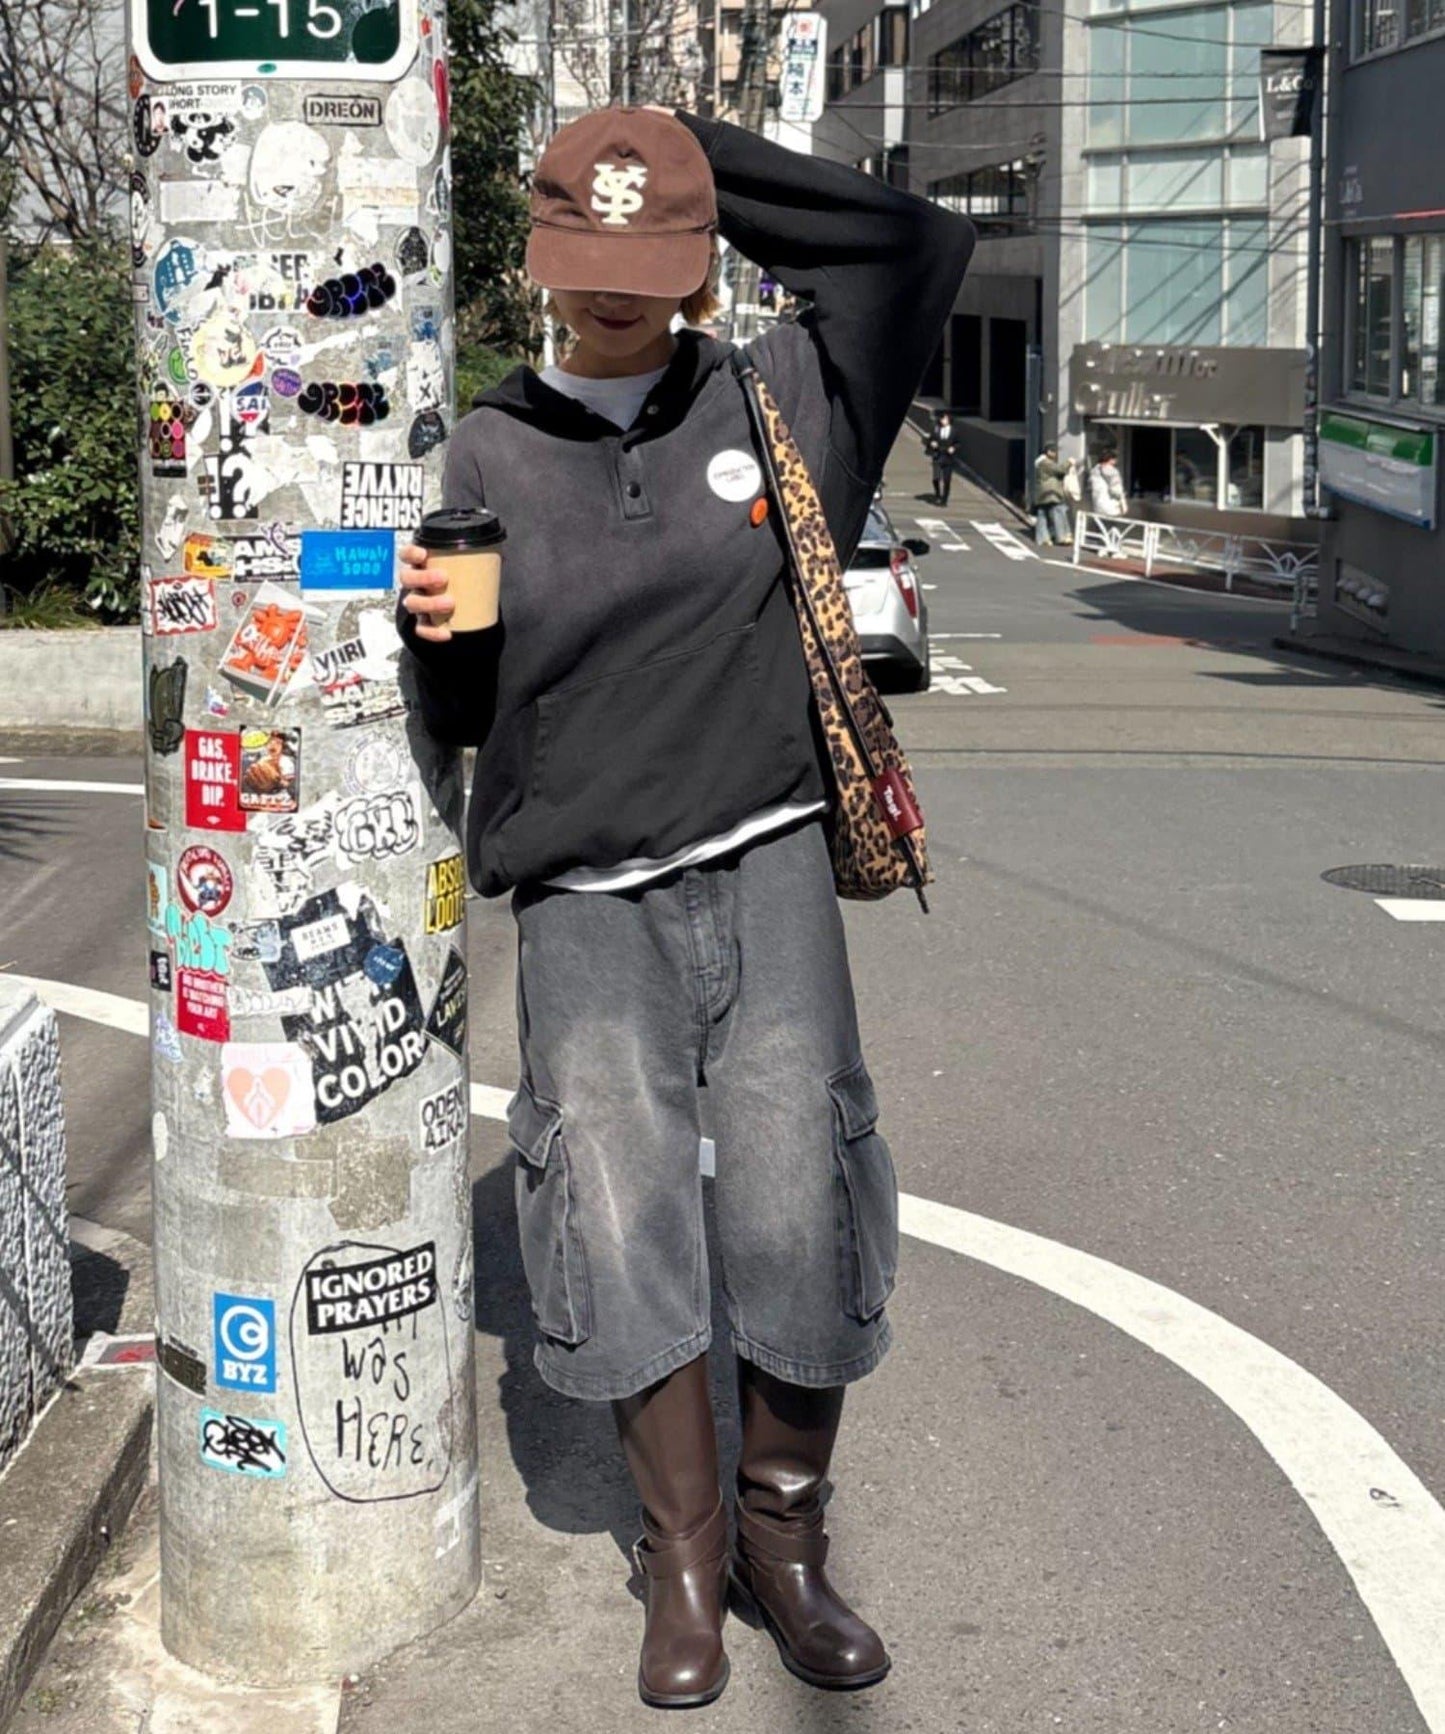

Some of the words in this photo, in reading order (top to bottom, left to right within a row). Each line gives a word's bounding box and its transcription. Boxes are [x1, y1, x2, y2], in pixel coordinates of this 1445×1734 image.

[198, 0, 343, 39] 1-15
[197, 85, 237, 96] STORY
[344, 463, 423, 497] RKYVE
[342, 496, 421, 529] SCIENCE
[317, 1030, 423, 1108] COLOR
[311, 1250, 434, 1301] IGNORED
[317, 1276, 432, 1328] PRAYERS
[222, 1358, 269, 1386] BYZ
